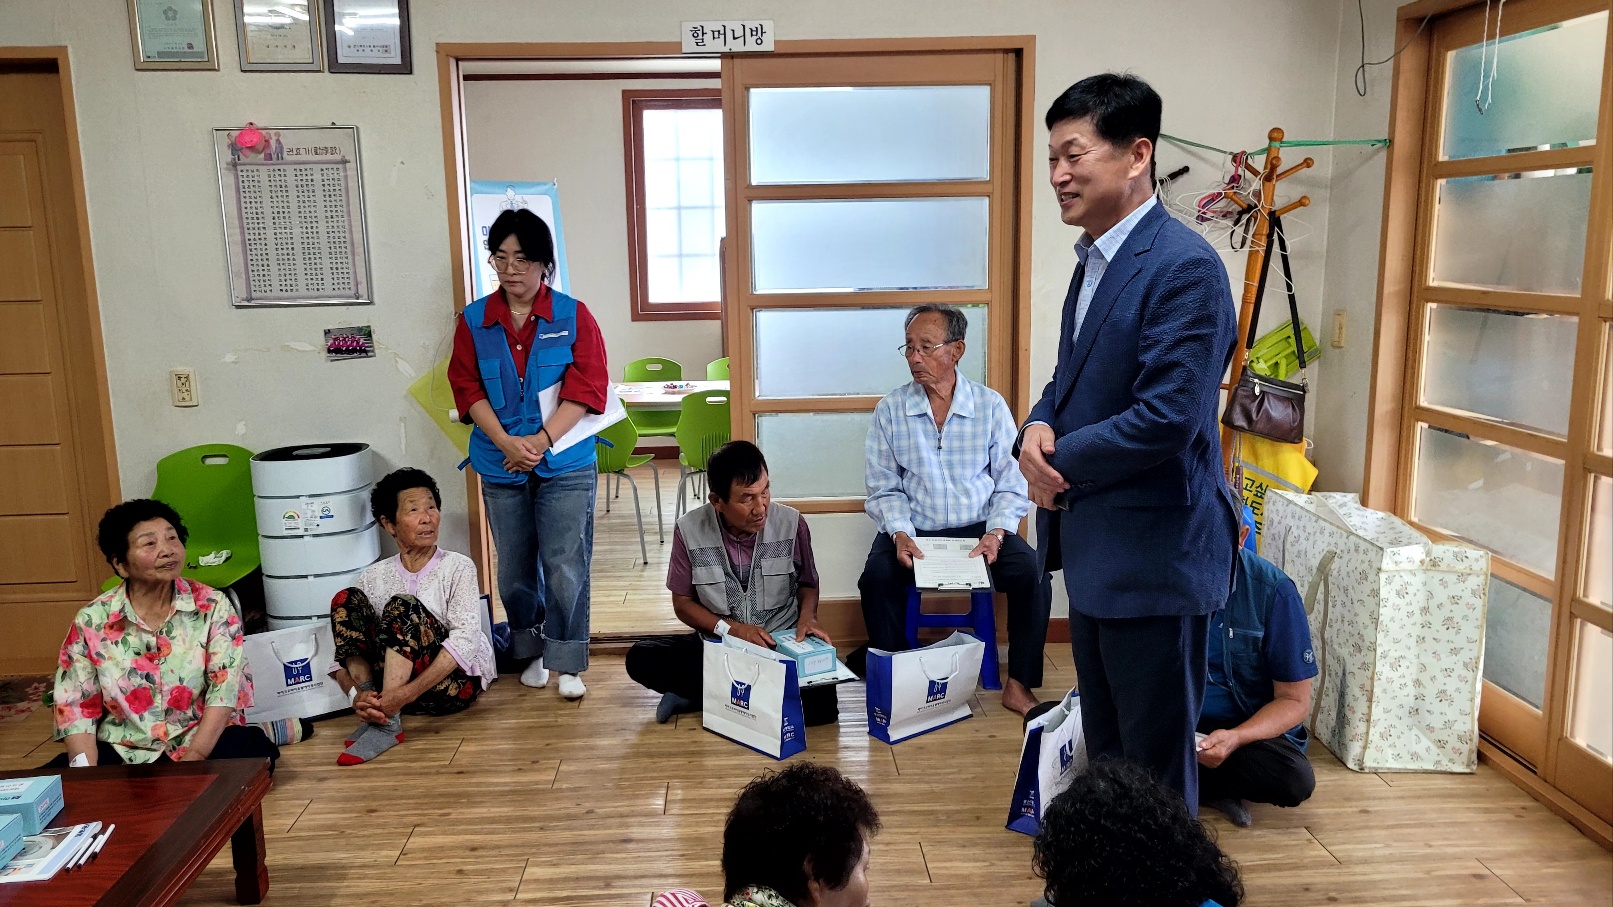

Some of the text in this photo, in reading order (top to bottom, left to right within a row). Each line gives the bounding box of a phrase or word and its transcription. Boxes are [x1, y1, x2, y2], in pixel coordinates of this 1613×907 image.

[689, 23, 767, 47] 할머니방
[287, 674, 311, 685] MARC
[731, 696, 748, 708] MARC
[928, 692, 945, 702] MARC
